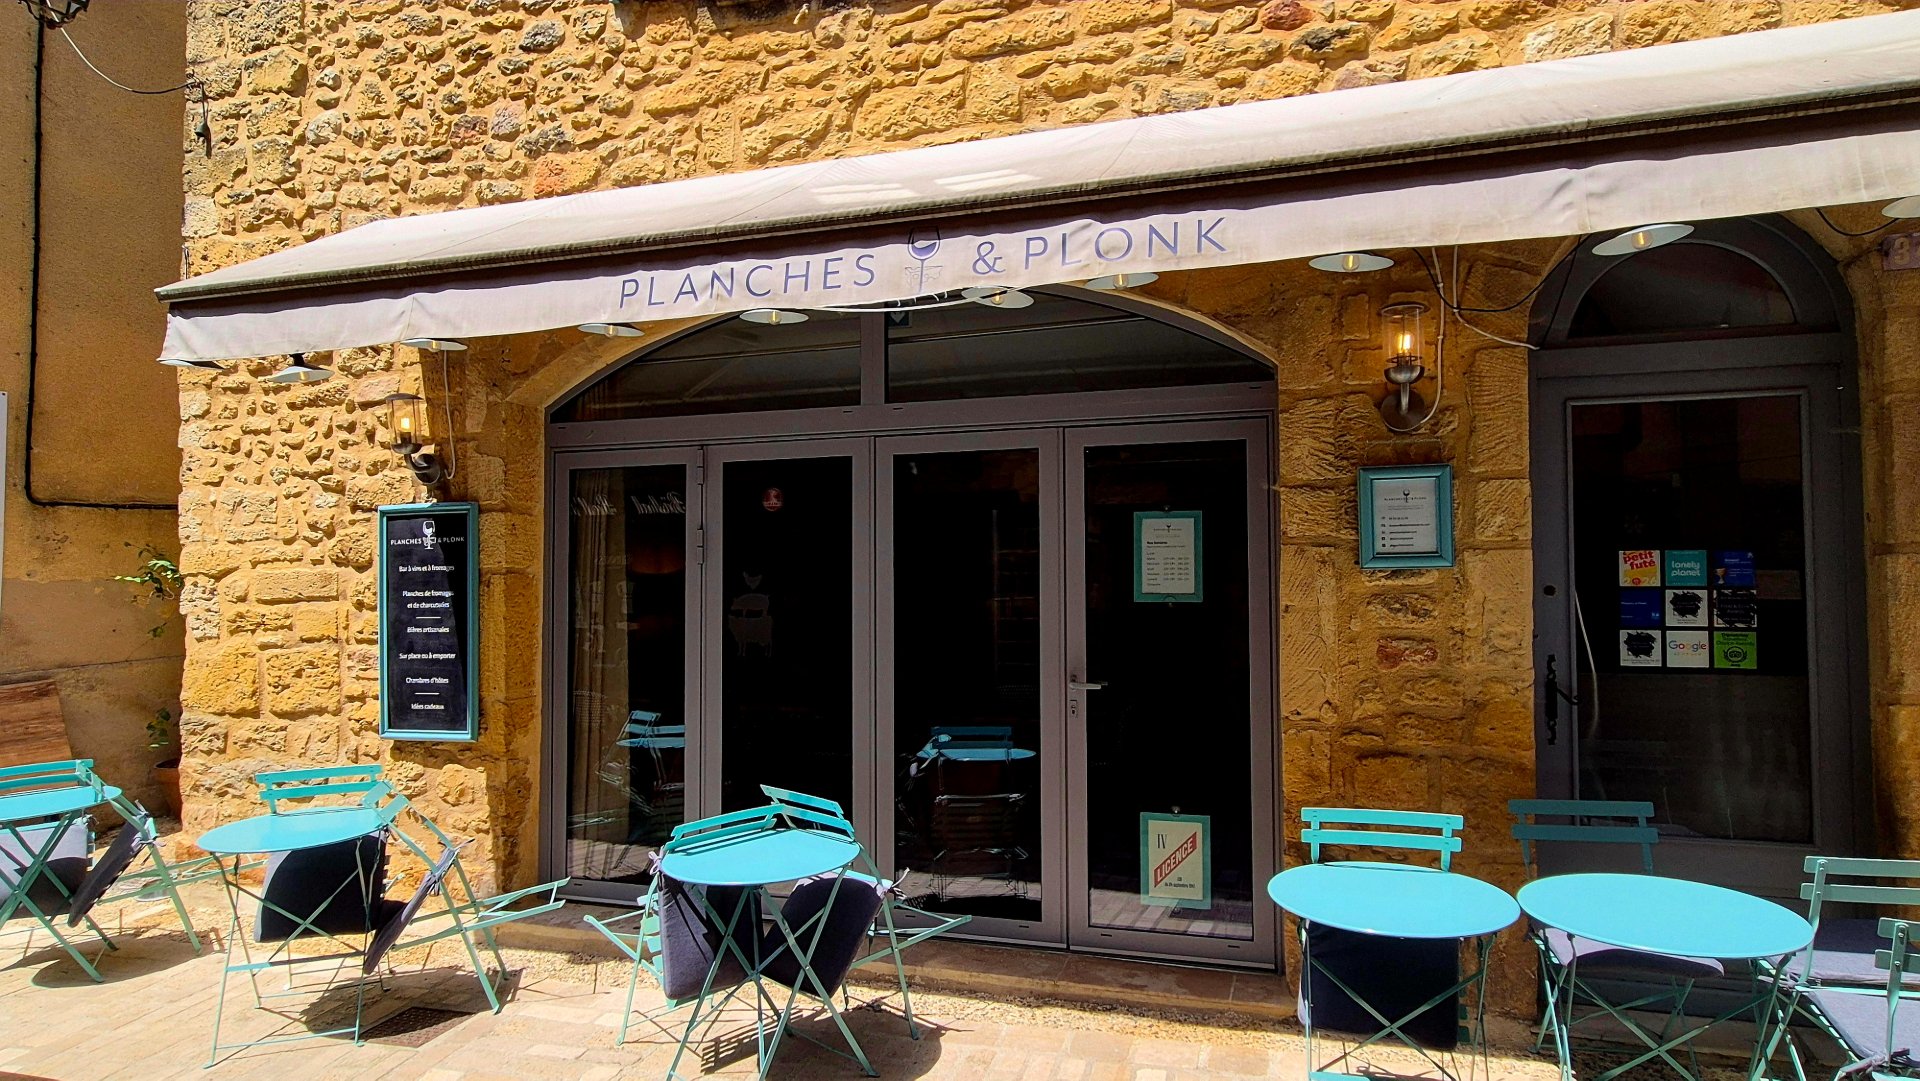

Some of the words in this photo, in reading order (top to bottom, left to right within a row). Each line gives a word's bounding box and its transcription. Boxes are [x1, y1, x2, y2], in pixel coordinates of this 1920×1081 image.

[619, 253, 877, 309] PLANCHES
[972, 241, 1004, 276] &
[1024, 215, 1228, 262] PLONK
[390, 538, 422, 546] PLANCHES
[1622, 551, 1654, 564] petit
[1629, 559, 1656, 570] futé
[1671, 560, 1701, 570] lonely
[1671, 568, 1701, 577] planet
[1668, 640, 1707, 652] Google
[408, 652, 421, 660] place
[433, 652, 456, 660] emporter
[1157, 833, 1167, 849] IV
[1156, 837, 1194, 883] LICENCE
